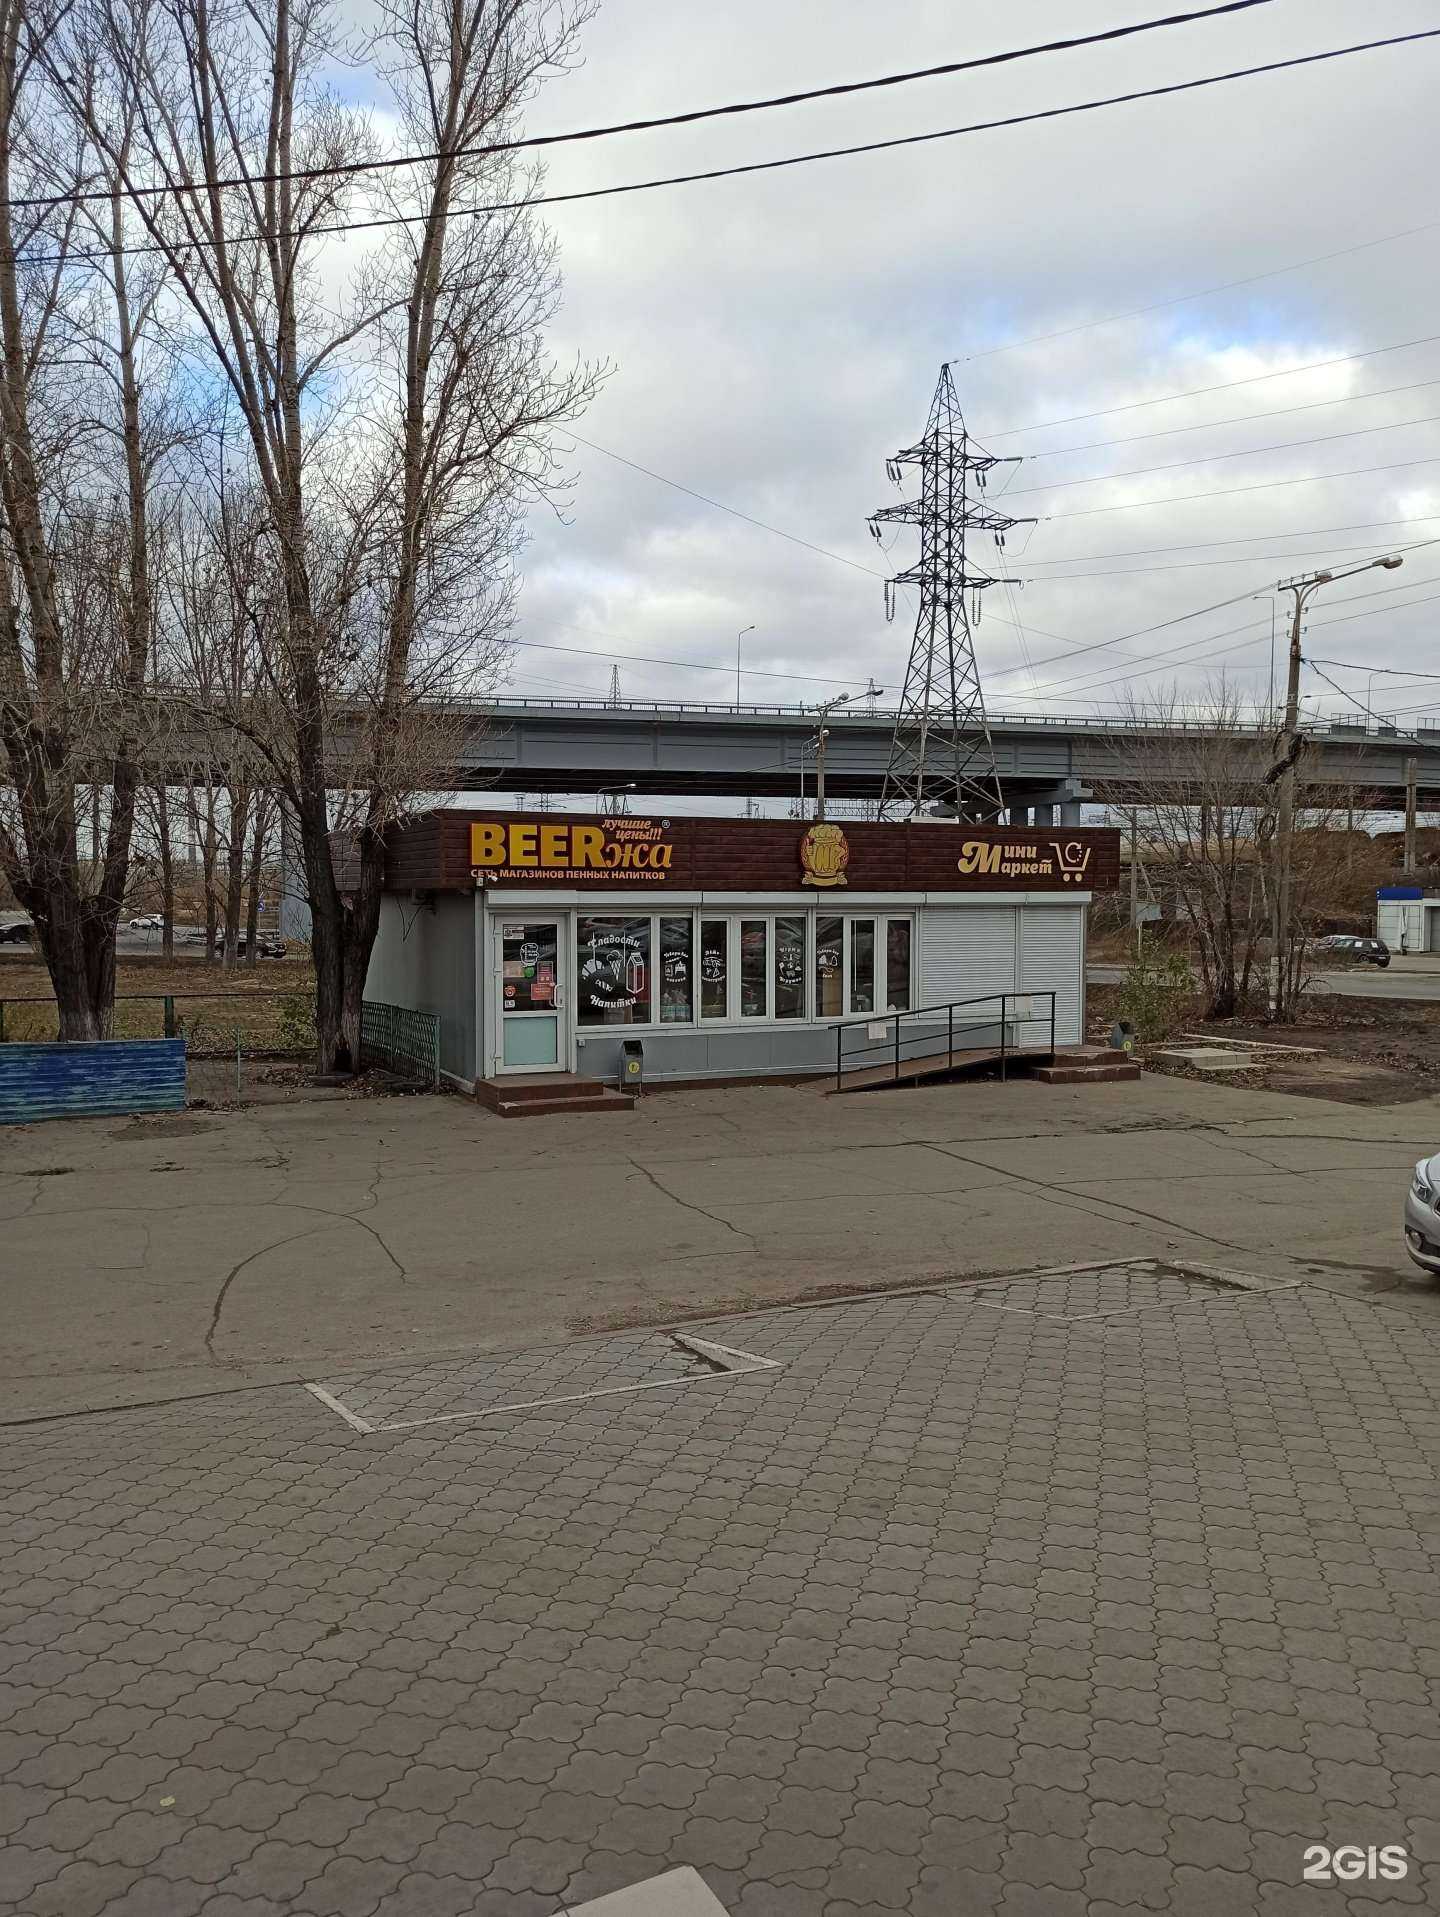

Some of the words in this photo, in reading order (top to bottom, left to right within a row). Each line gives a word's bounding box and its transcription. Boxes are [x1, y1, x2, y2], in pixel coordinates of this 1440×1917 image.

[602, 818, 653, 831] лучшие
[615, 828, 661, 841] цены!!!
[470, 868, 499, 879] СЕТЬ
[499, 869, 565, 879] МАГАЗИНОВ
[566, 870, 609, 880] ПЕННЫХ
[611, 871, 665, 880] НАПИТКОВ
[587, 934, 641, 948] Сладости
[590, 994, 637, 1009] Напитки
